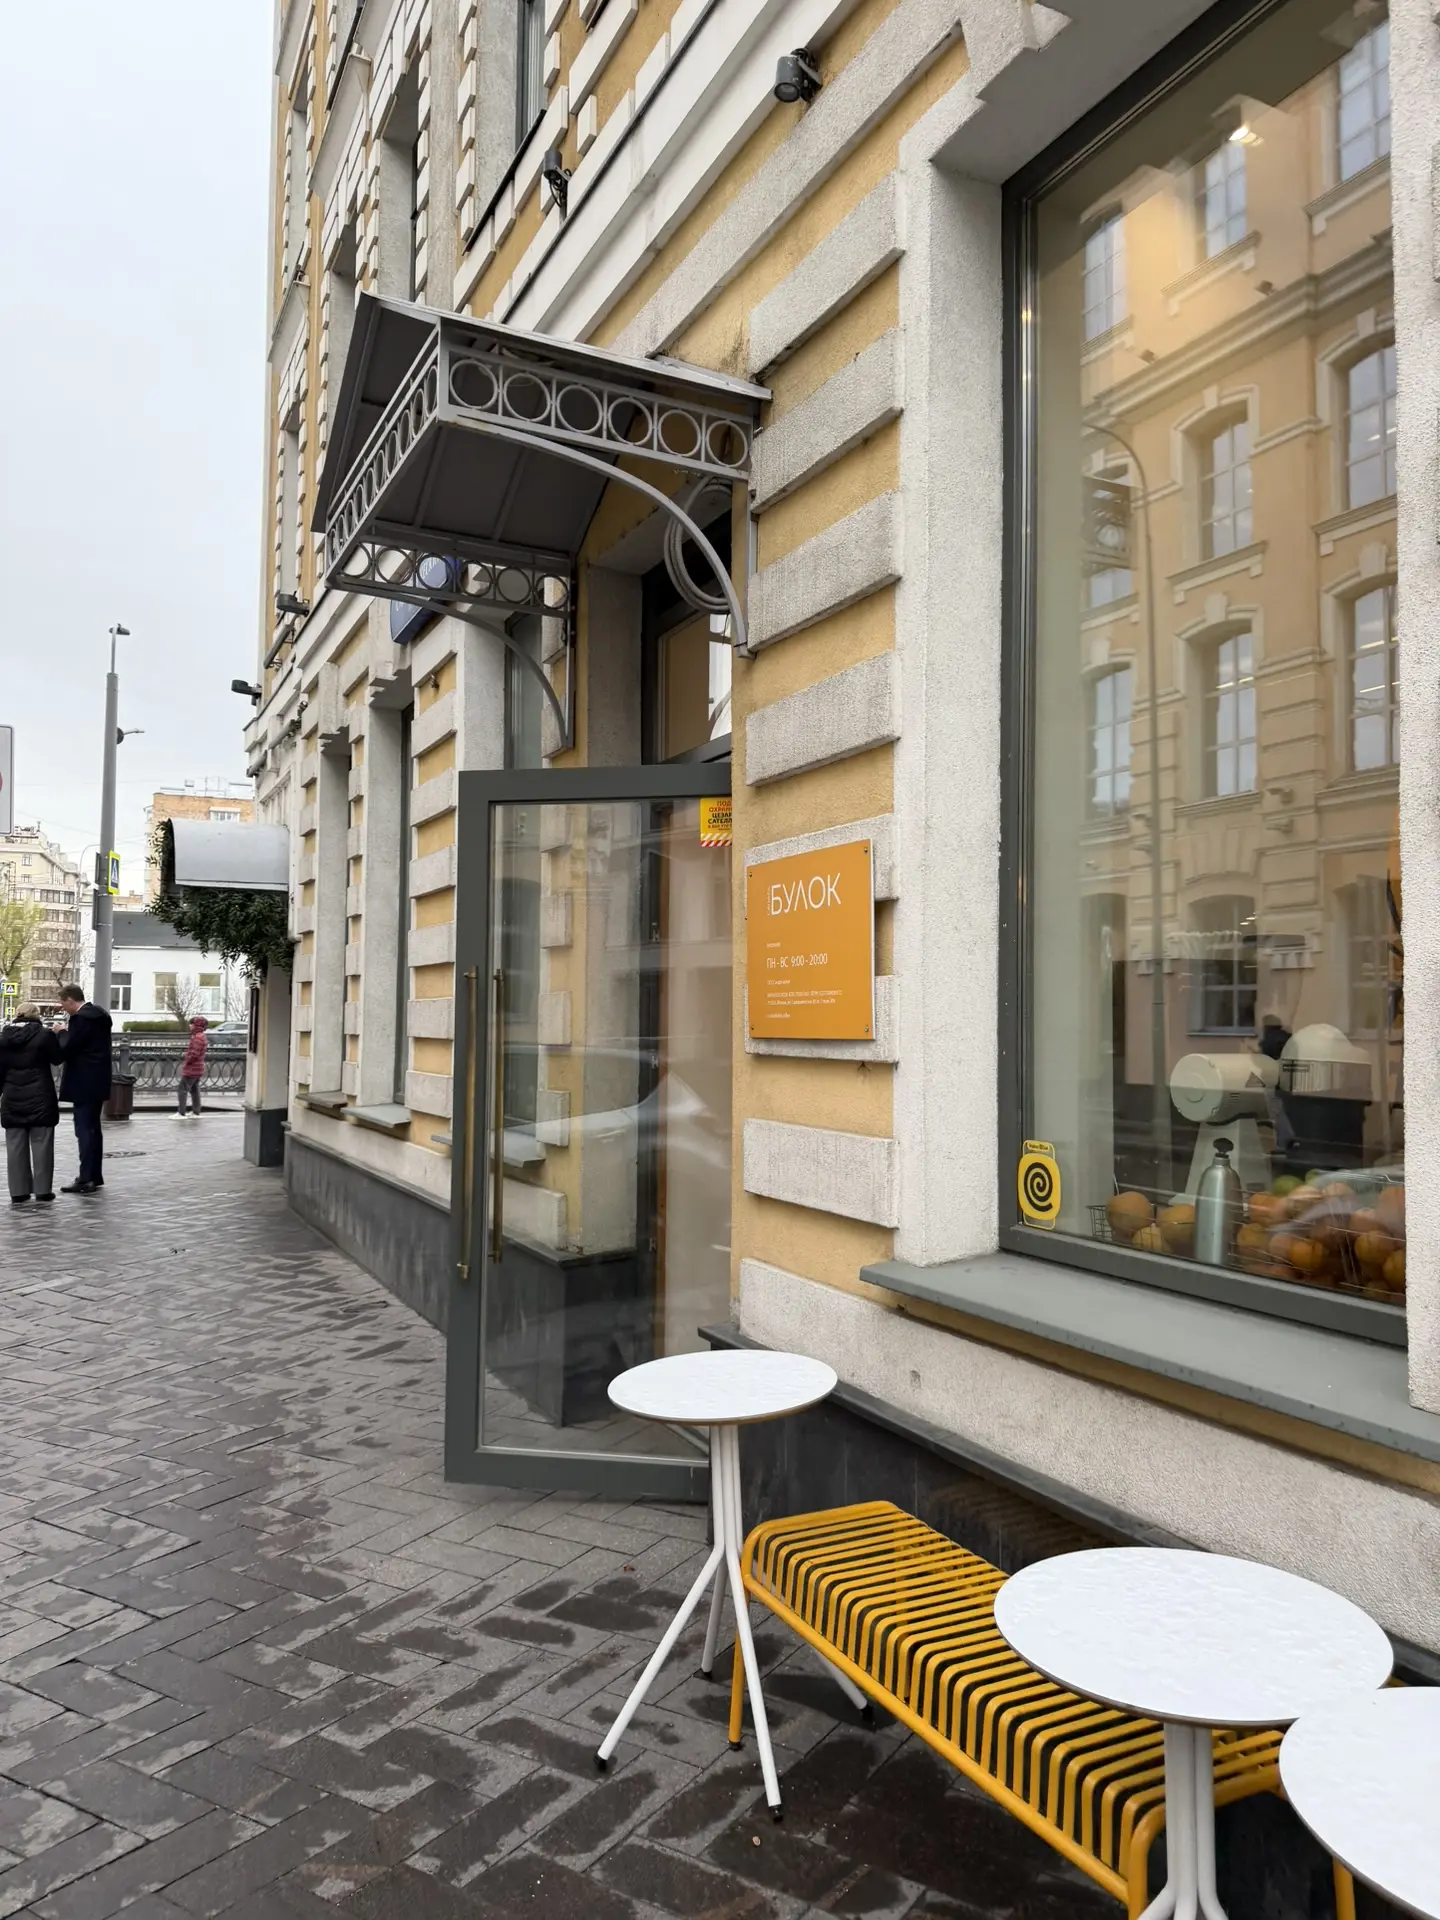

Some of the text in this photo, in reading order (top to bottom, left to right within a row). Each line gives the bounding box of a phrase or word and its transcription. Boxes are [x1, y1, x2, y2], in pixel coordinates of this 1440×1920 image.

[771, 872, 842, 915] БУЛОК
[766, 957, 776, 969] ПН
[780, 956, 789, 968] ВС
[791, 955, 805, 967] 9:00
[809, 953, 828, 966] 20:00
